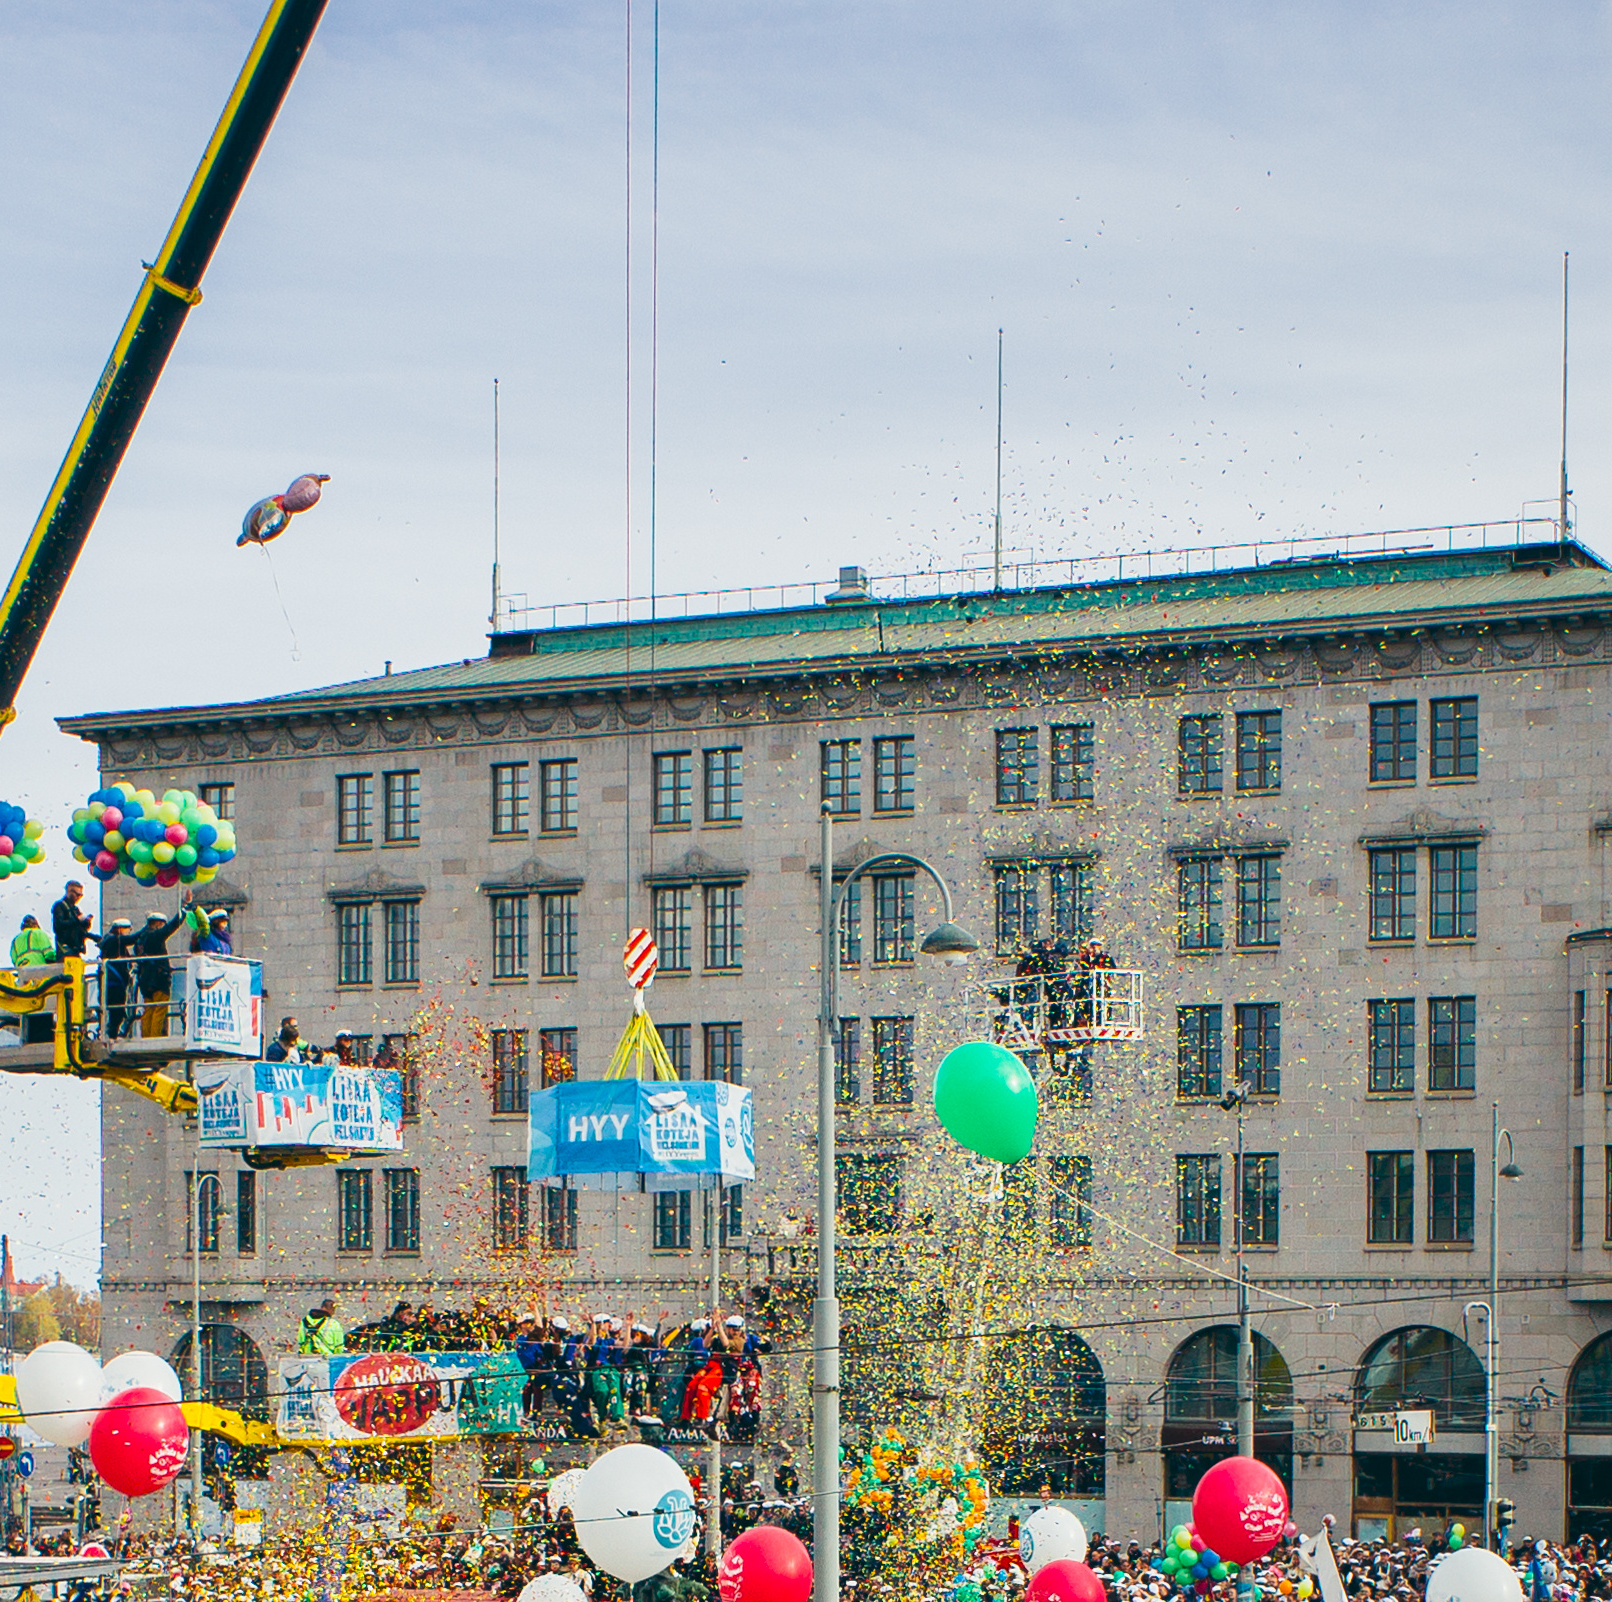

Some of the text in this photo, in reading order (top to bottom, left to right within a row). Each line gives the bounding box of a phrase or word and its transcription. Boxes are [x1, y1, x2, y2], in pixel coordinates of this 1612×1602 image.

[569, 1114, 630, 1142] HYY
[656, 1129, 699, 1140] KOTEJA
[668, 1427, 730, 1440] AMANA
